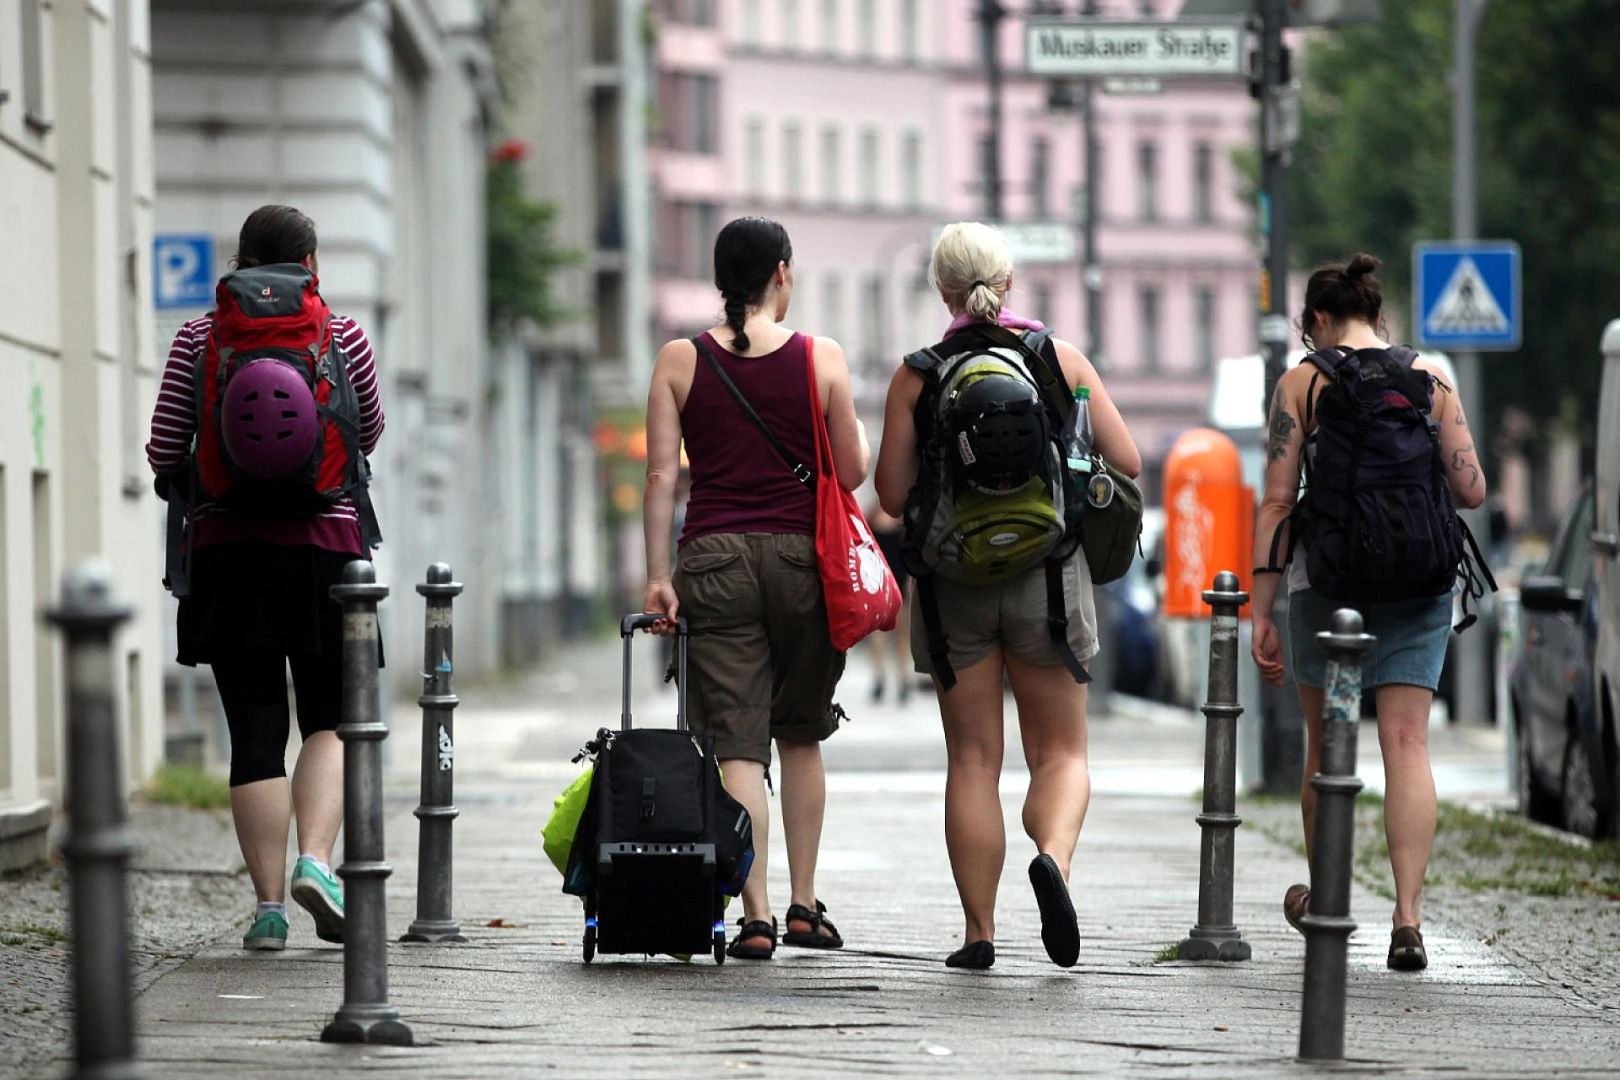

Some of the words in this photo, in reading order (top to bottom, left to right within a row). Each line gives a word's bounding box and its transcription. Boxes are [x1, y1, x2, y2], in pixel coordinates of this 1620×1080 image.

[1039, 31, 1147, 58] Muskauer
[1155, 29, 1231, 65] Straße
[159, 244, 198, 299] P
